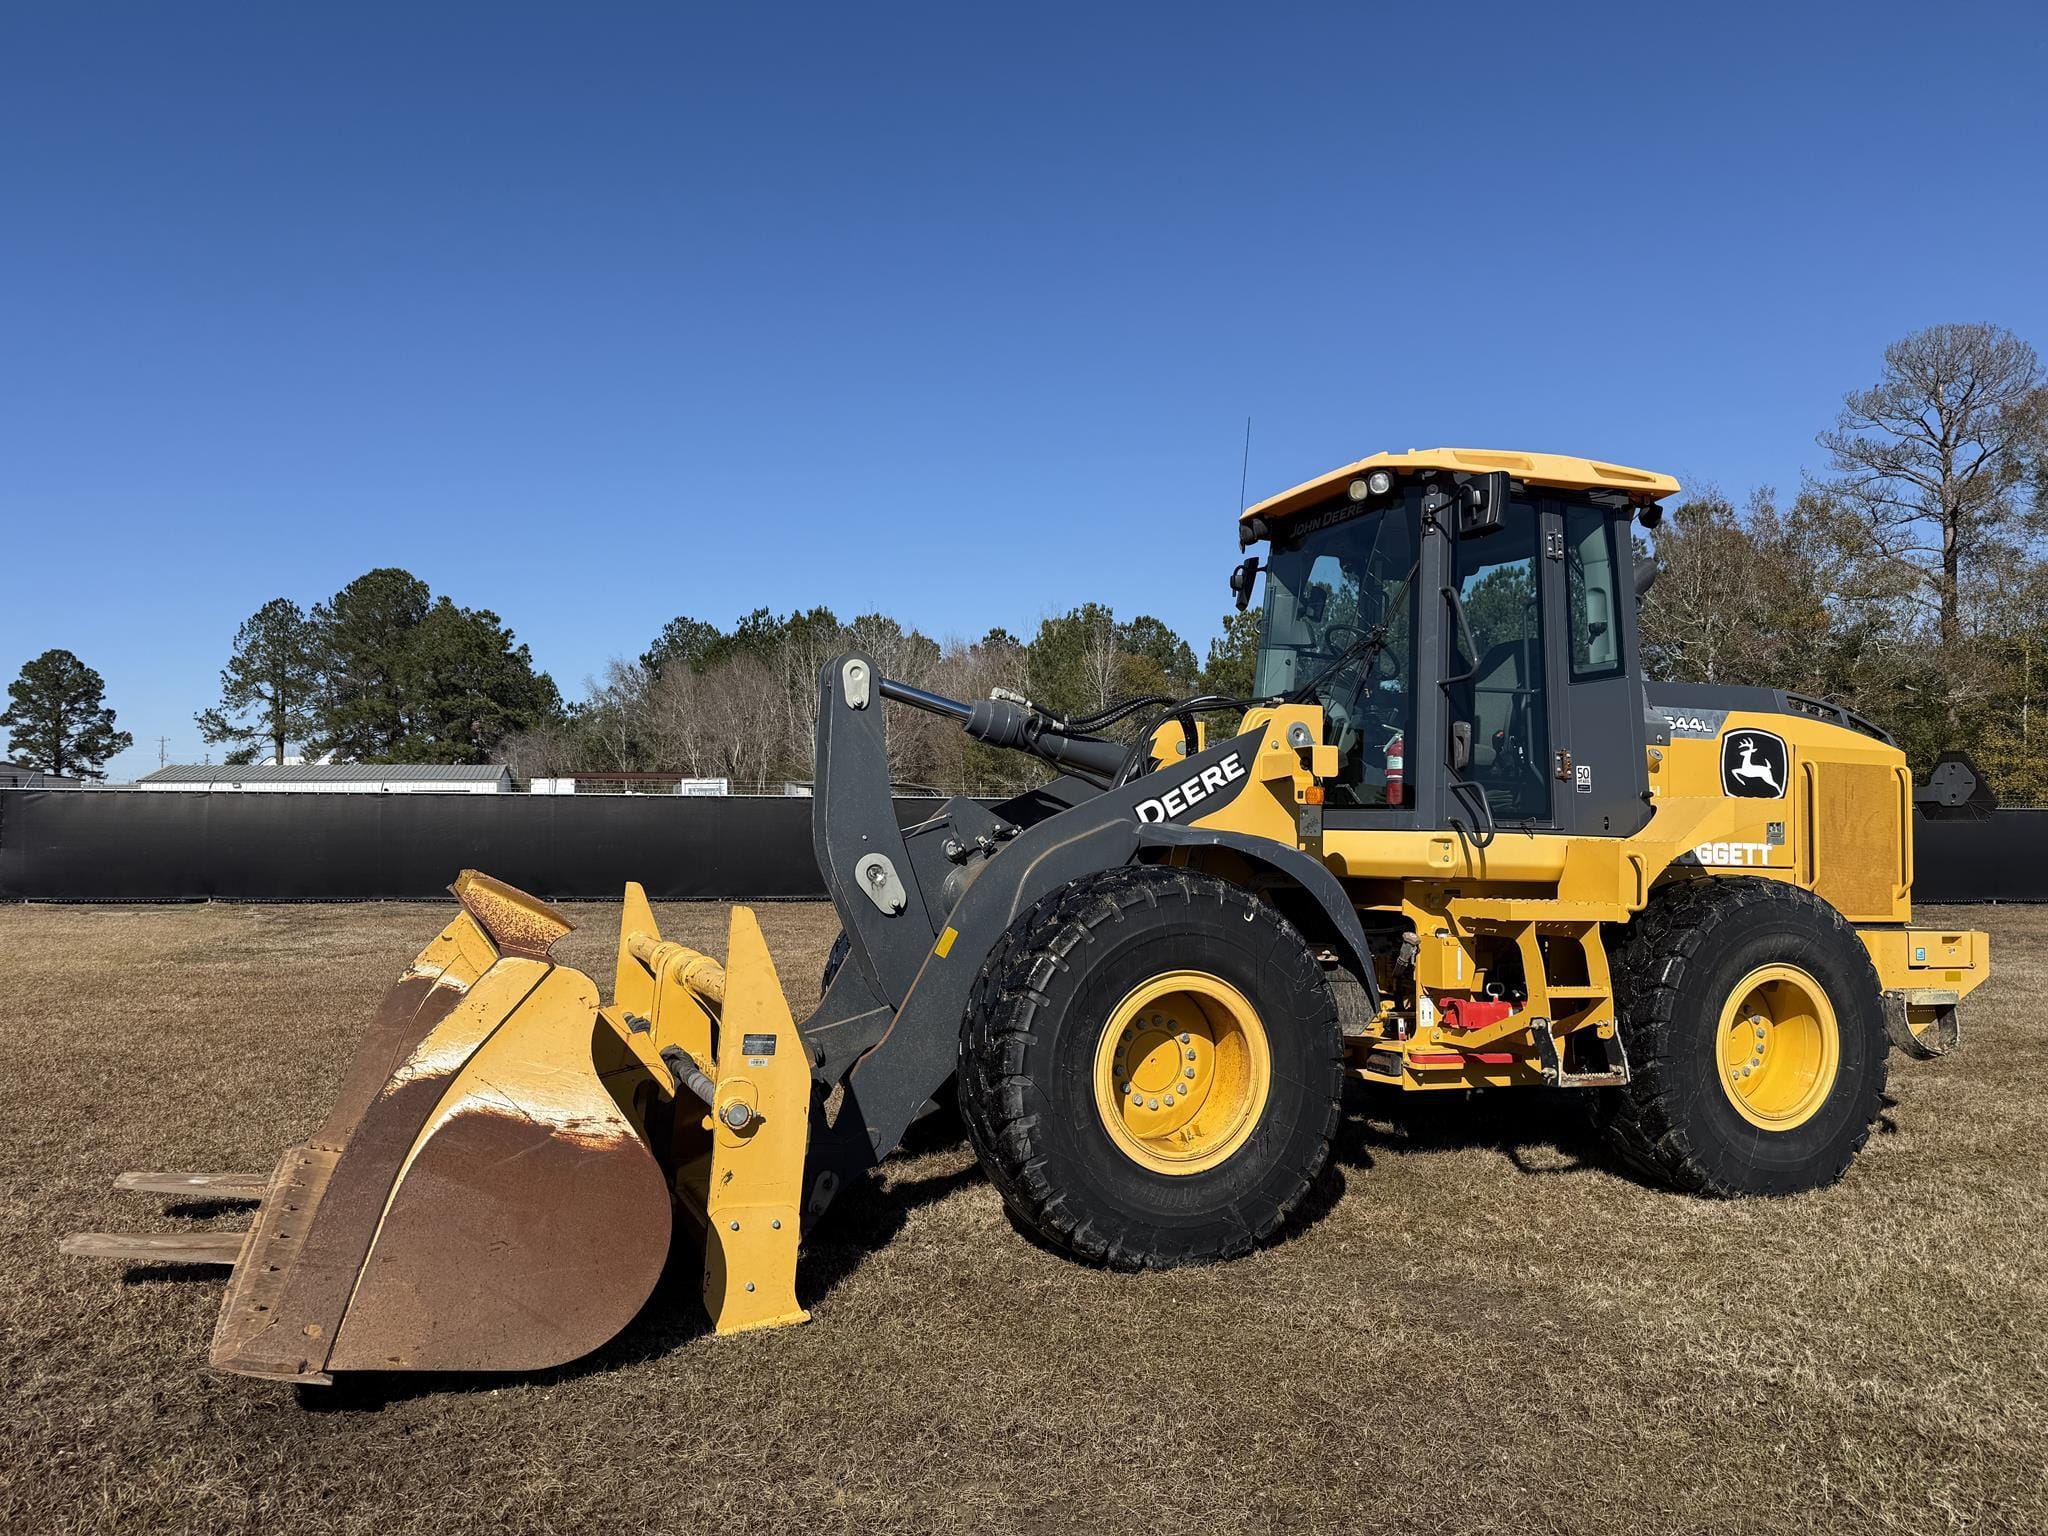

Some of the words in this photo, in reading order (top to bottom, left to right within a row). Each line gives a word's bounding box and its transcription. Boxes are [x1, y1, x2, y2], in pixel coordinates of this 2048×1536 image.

[1289, 517, 1321, 538] JOHN
[1322, 501, 1366, 527] DEERE
[1663, 715, 1713, 732] 544L
[1577, 767, 1590, 779] 50
[1135, 752, 1246, 823] DEERE
